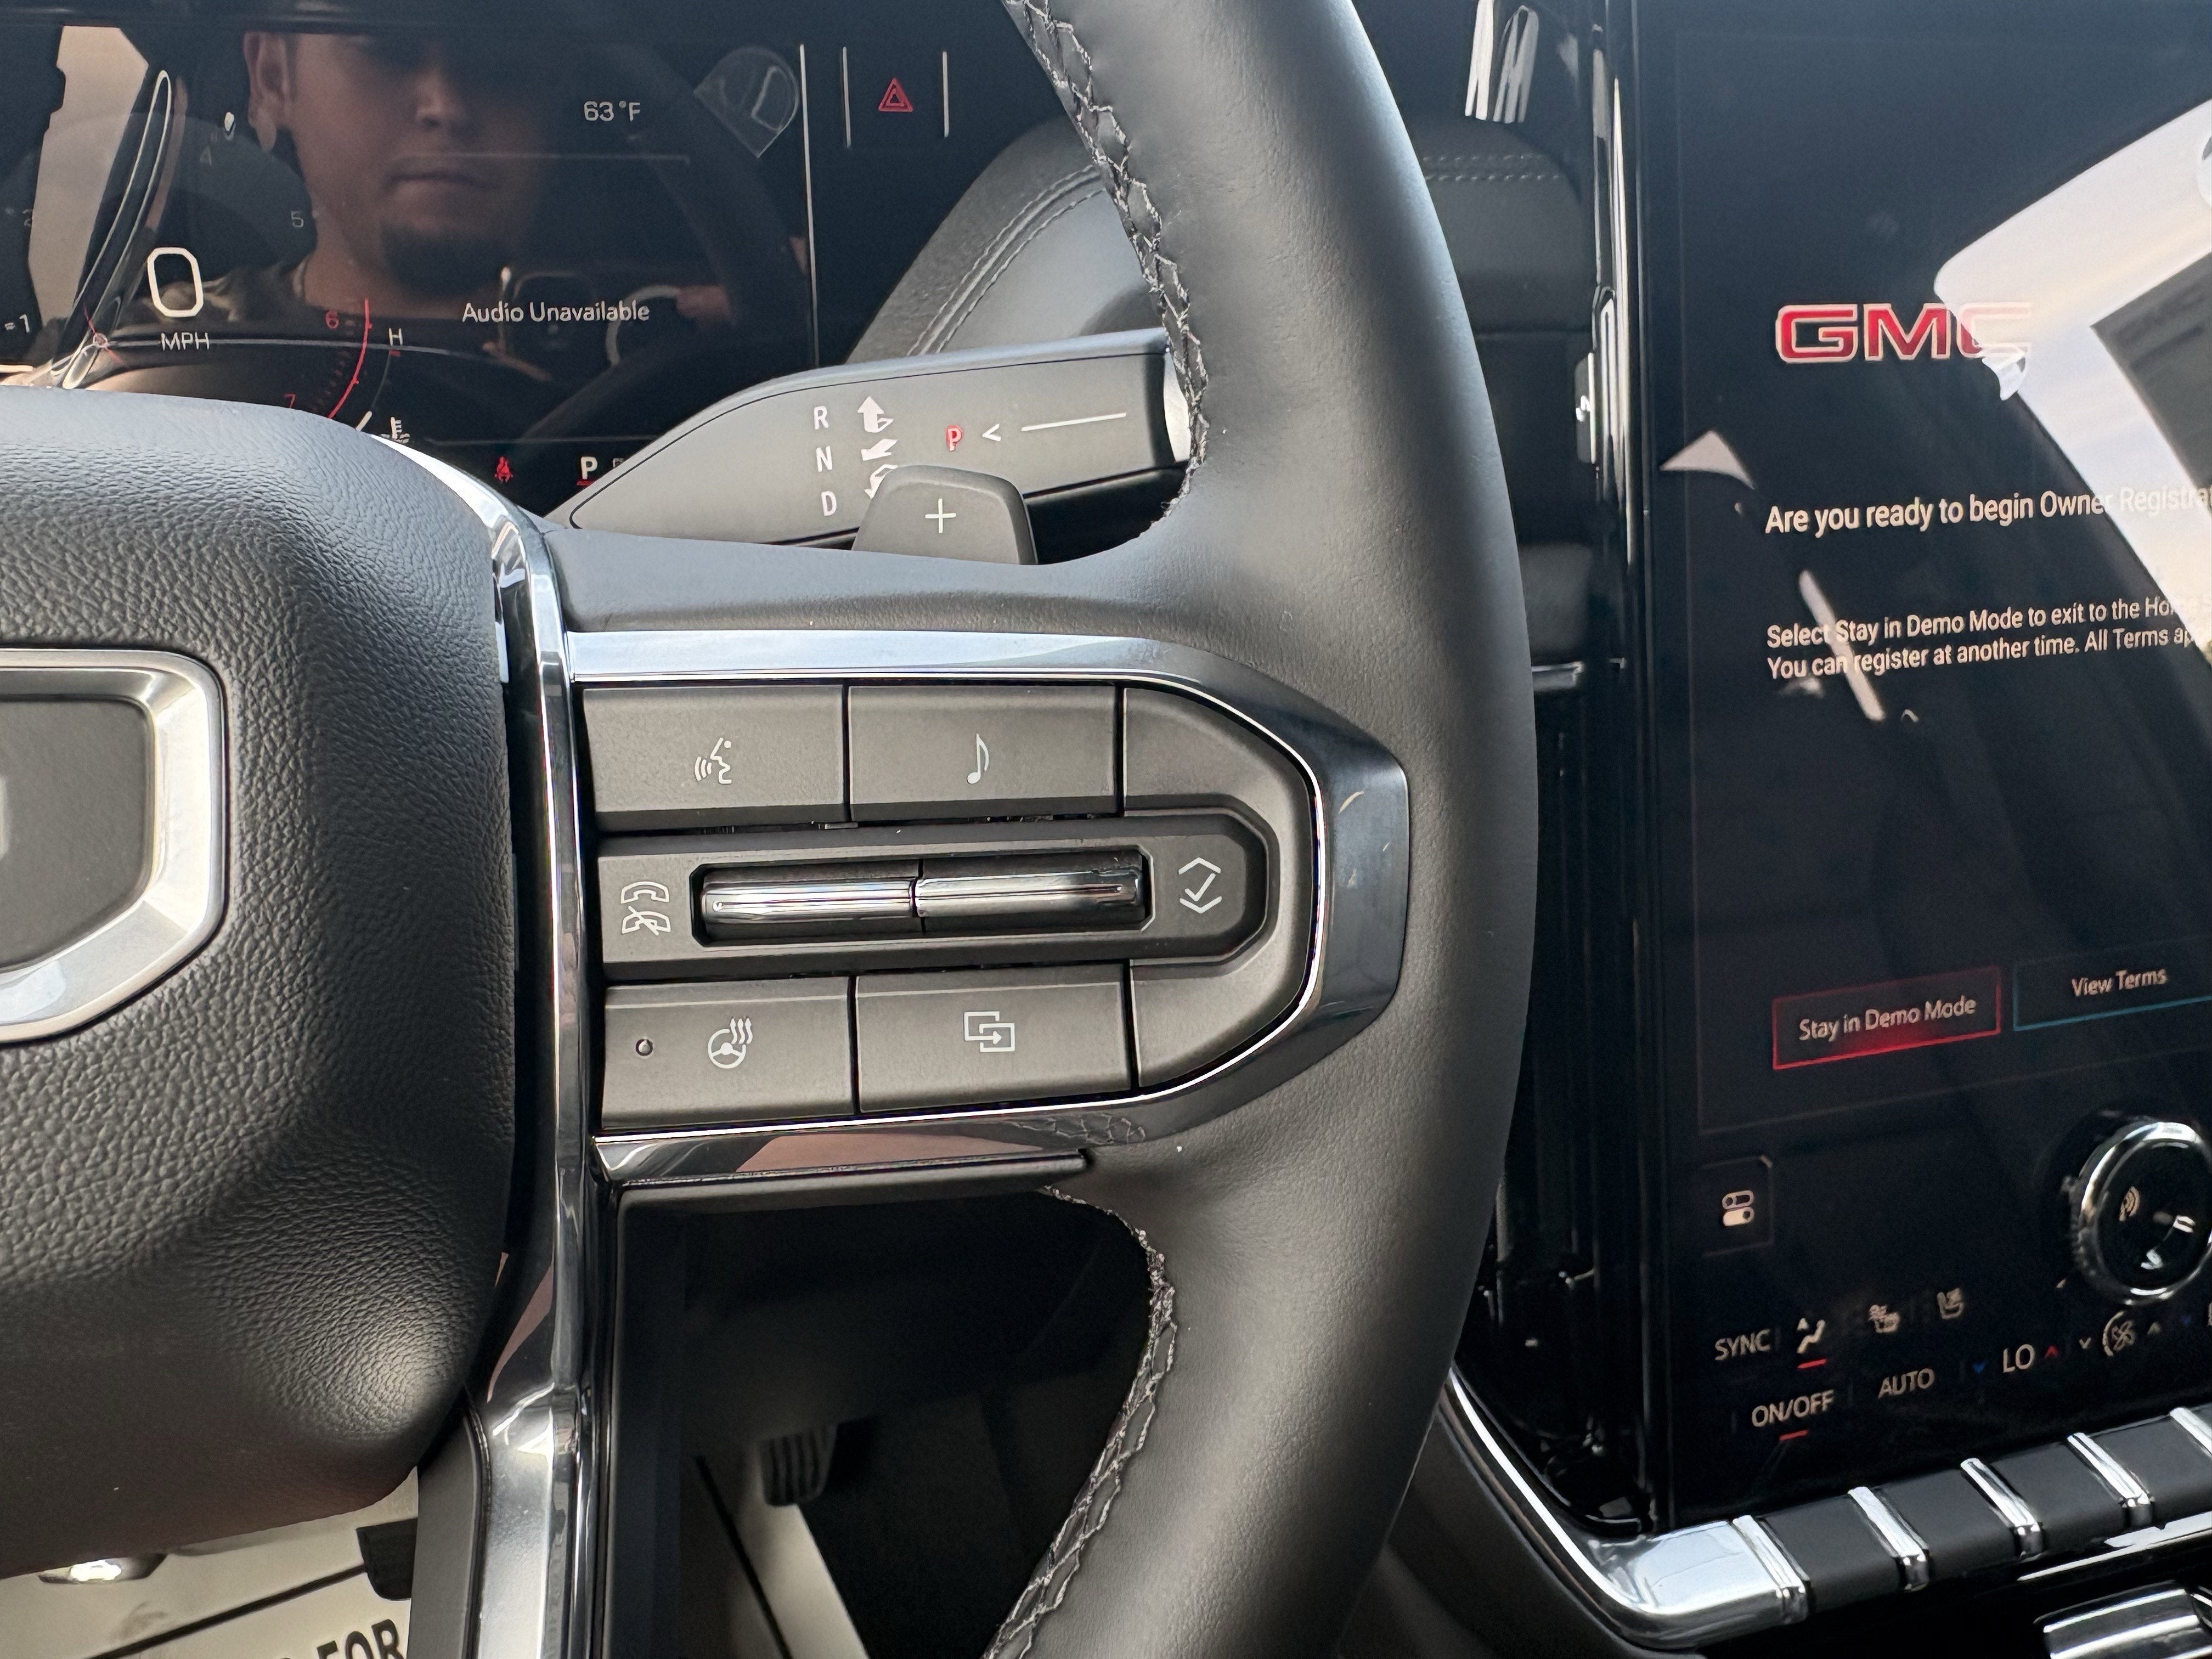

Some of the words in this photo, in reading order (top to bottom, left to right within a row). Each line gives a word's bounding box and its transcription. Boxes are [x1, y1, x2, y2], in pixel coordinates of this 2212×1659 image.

[291, 211, 304, 228] 5
[147, 247, 204, 318] 0
[325, 309, 340, 329] 6
[462, 301, 524, 323] Audio
[529, 300, 650, 322] Unavailable
[161, 331, 210, 351] MPH
[388, 328, 404, 346] H
[1775, 302, 2032, 364] GMC
[813, 405, 830, 430] R
[945, 425, 963, 452] P
[580, 456, 598, 479] P
[816, 445, 833, 472] N
[821, 490, 837, 516] D
[1765, 505, 1809, 534] Are
[1814, 507, 1860, 538] you
[1866, 496, 1934, 532] ready
[1939, 498, 1963, 524] to
[1970, 492, 2034, 527] begin
[2040, 490, 2113, 518] Owner
[2119, 483, 2212, 518] Registra
[1767, 623, 1830, 648] Select
[1836, 619, 1879, 646] Stay
[1884, 617, 1901, 639] in
[1907, 614, 1964, 637] Demo
[1970, 606, 2023, 632] Mode
[2028, 607, 2046, 627] to
[2051, 602, 2086, 625] exit
[2089, 603, 2107, 622] to
[2112, 598, 2140, 620] the
[1767, 656, 1807, 680] You
[1812, 655, 1848, 676] can
[1854, 647, 1929, 676] register
[1933, 644, 1953, 665] at
[1957, 636, 2030, 662] another
[2034, 634, 2080, 657] time.
[2085, 628, 2108, 652] All
[2112, 627, 2169, 650] Terms
[2072, 977, 2113, 997] View
[2115, 968, 2168, 990] Terms
[1799, 1018, 1840, 1042] Stay
[1843, 1013, 1861, 1034] in
[1865, 1007, 1921, 1031] Demo
[1924, 995, 1977, 1020] Mode
[1714, 1328, 1771, 1361] SYNC
[2002, 1343, 2036, 1373] LO
[1877, 1368, 1935, 1399] AUTO
[1751, 1389, 1835, 1427] ON/OFF
